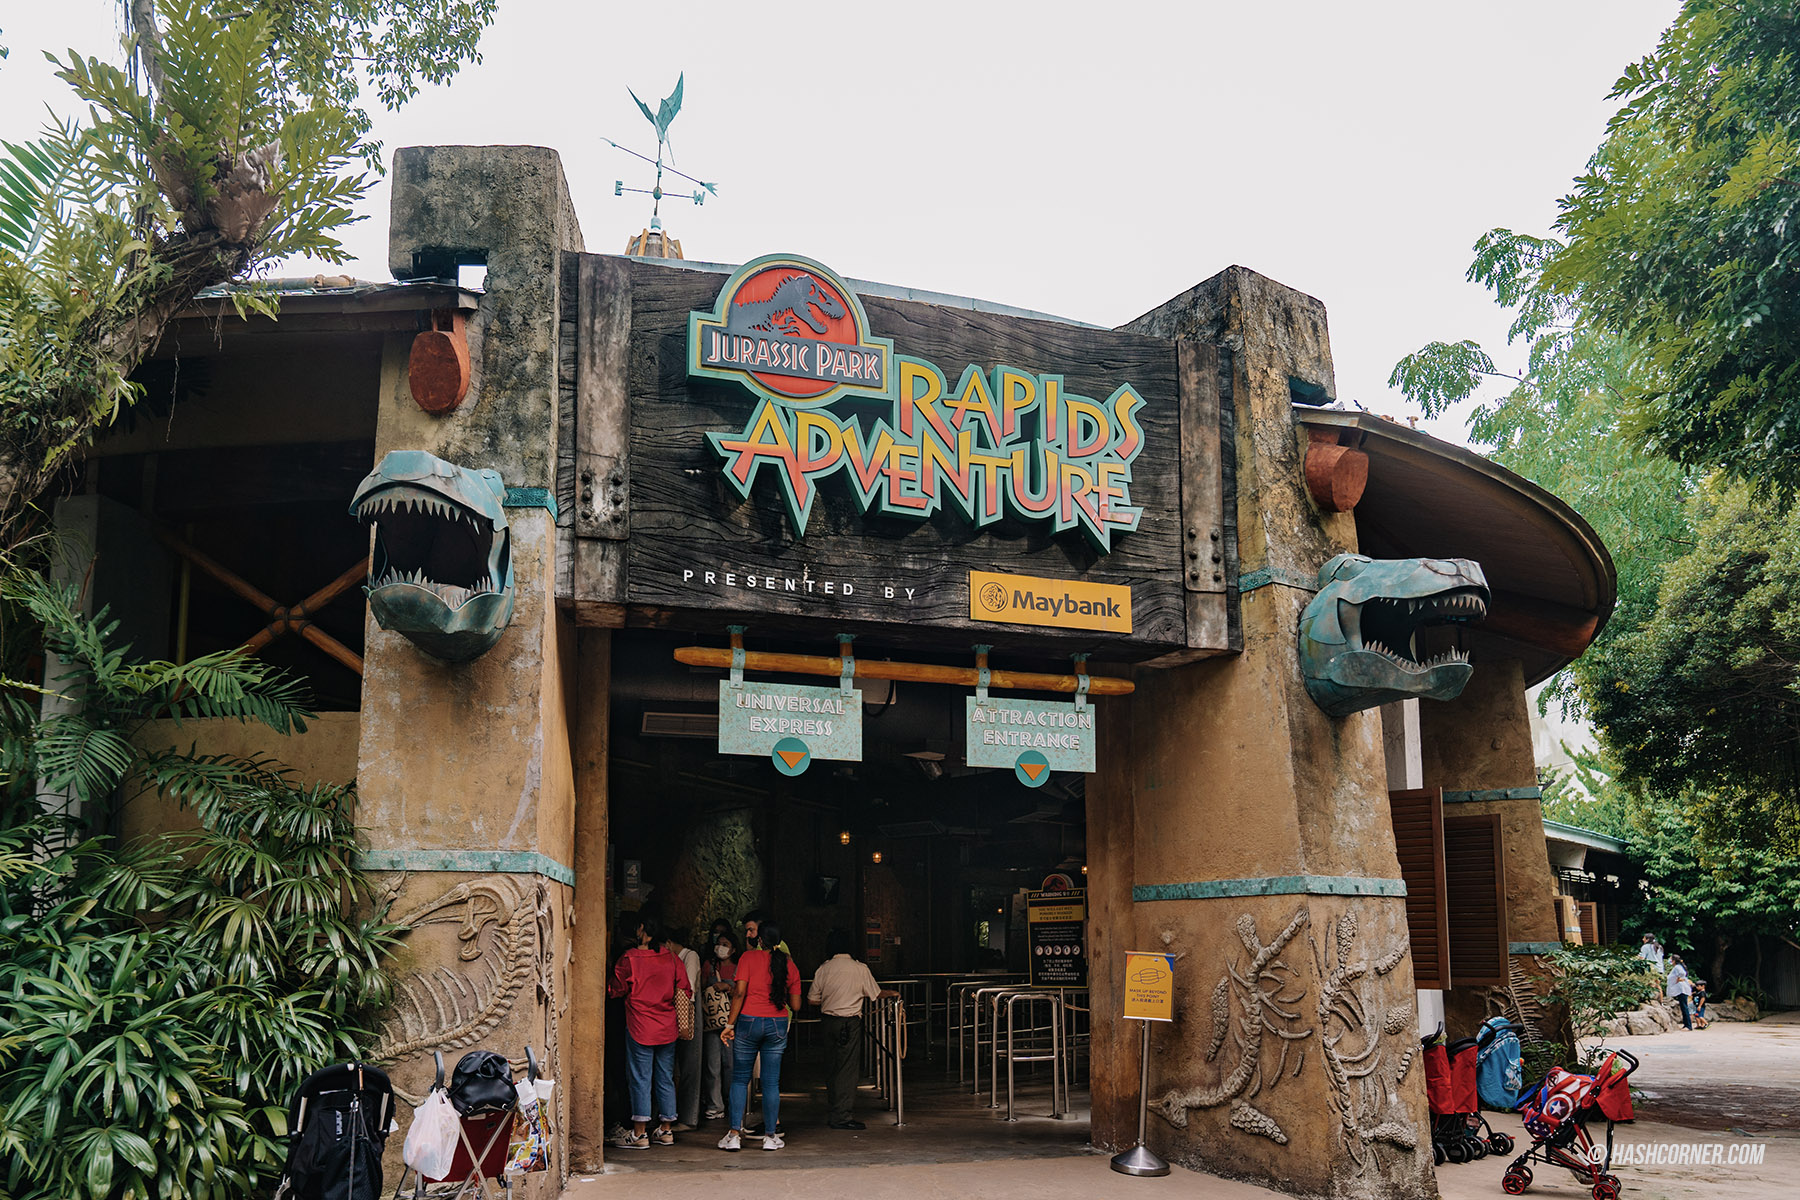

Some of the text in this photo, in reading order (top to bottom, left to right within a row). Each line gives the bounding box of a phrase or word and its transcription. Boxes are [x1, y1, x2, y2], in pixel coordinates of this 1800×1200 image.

[707, 330, 880, 381] JURASSIC PARK
[900, 361, 1137, 459] RAPIDS
[719, 399, 1135, 534] ADVENTURE
[683, 569, 915, 600] PRESENTED BY
[1012, 589, 1121, 618] Maybank
[736, 693, 846, 715] UNIVERSAL
[972, 707, 1092, 729] ATTRACTION
[749, 716, 833, 736] EXPRESS
[983, 729, 1080, 750] ENTRANCE
